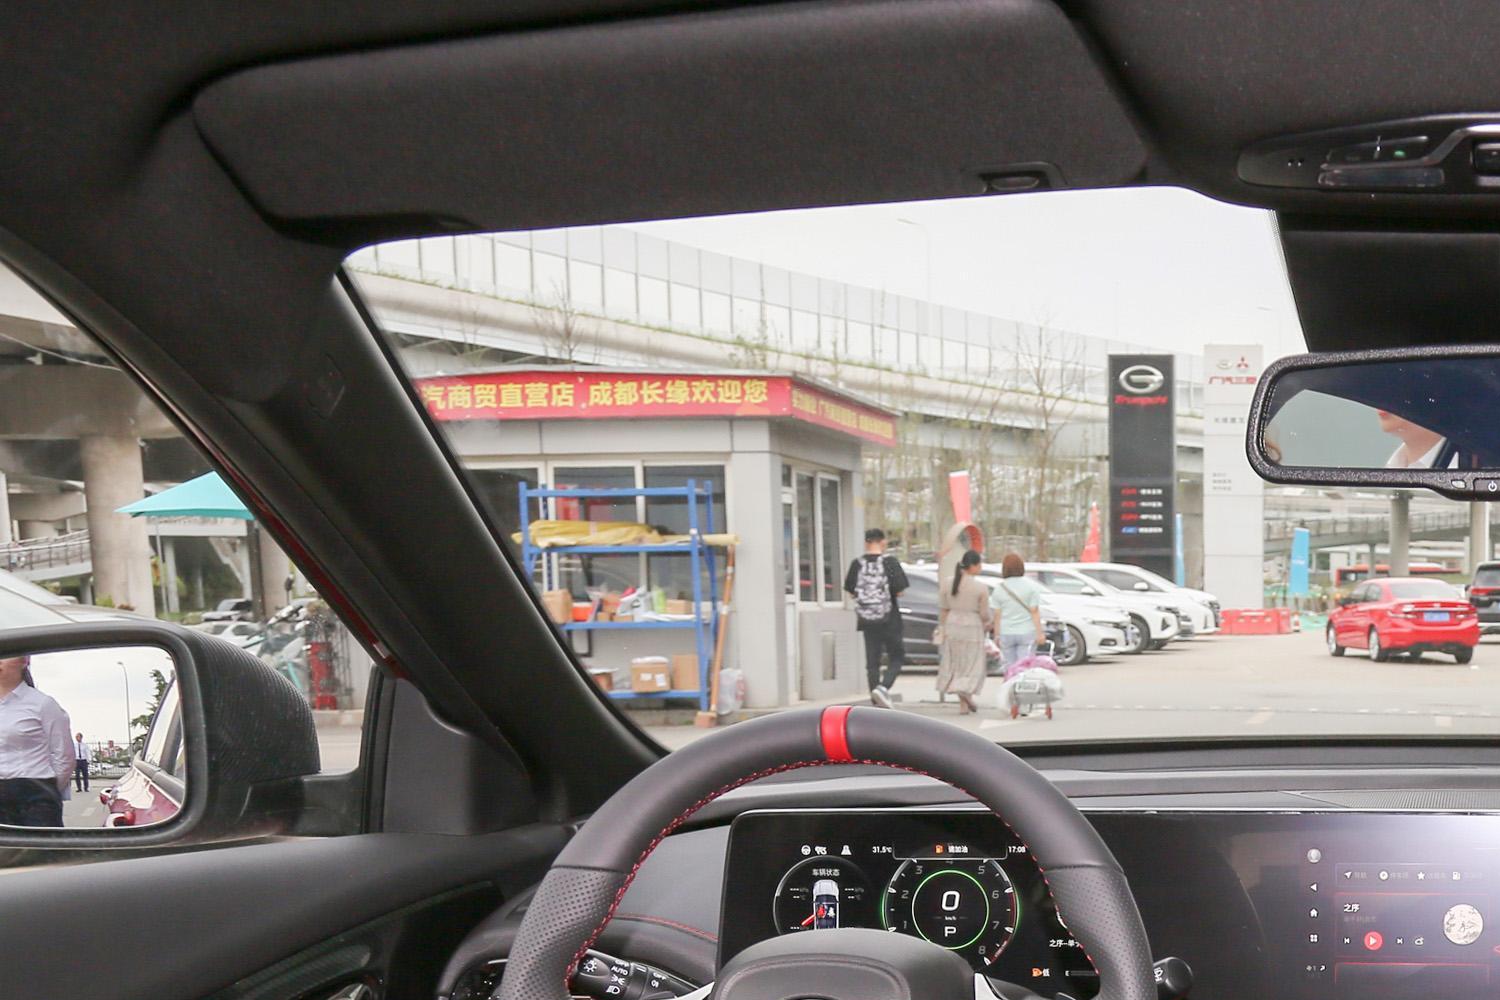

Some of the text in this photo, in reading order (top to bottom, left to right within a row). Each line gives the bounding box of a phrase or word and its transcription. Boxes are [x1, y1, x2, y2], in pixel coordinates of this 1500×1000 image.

[588, 379, 768, 407] 成都长缘欢迎您
[915, 865, 923, 875] 3
[977, 865, 986, 875] 5
[901, 889, 910, 899] 2
[991, 889, 1000, 899] 6
[941, 890, 961, 911] 0
[992, 921, 1000, 930] 7
[944, 926, 957, 937] P
[978, 945, 986, 954] 8
[611, 966, 629, 976] AUTO
